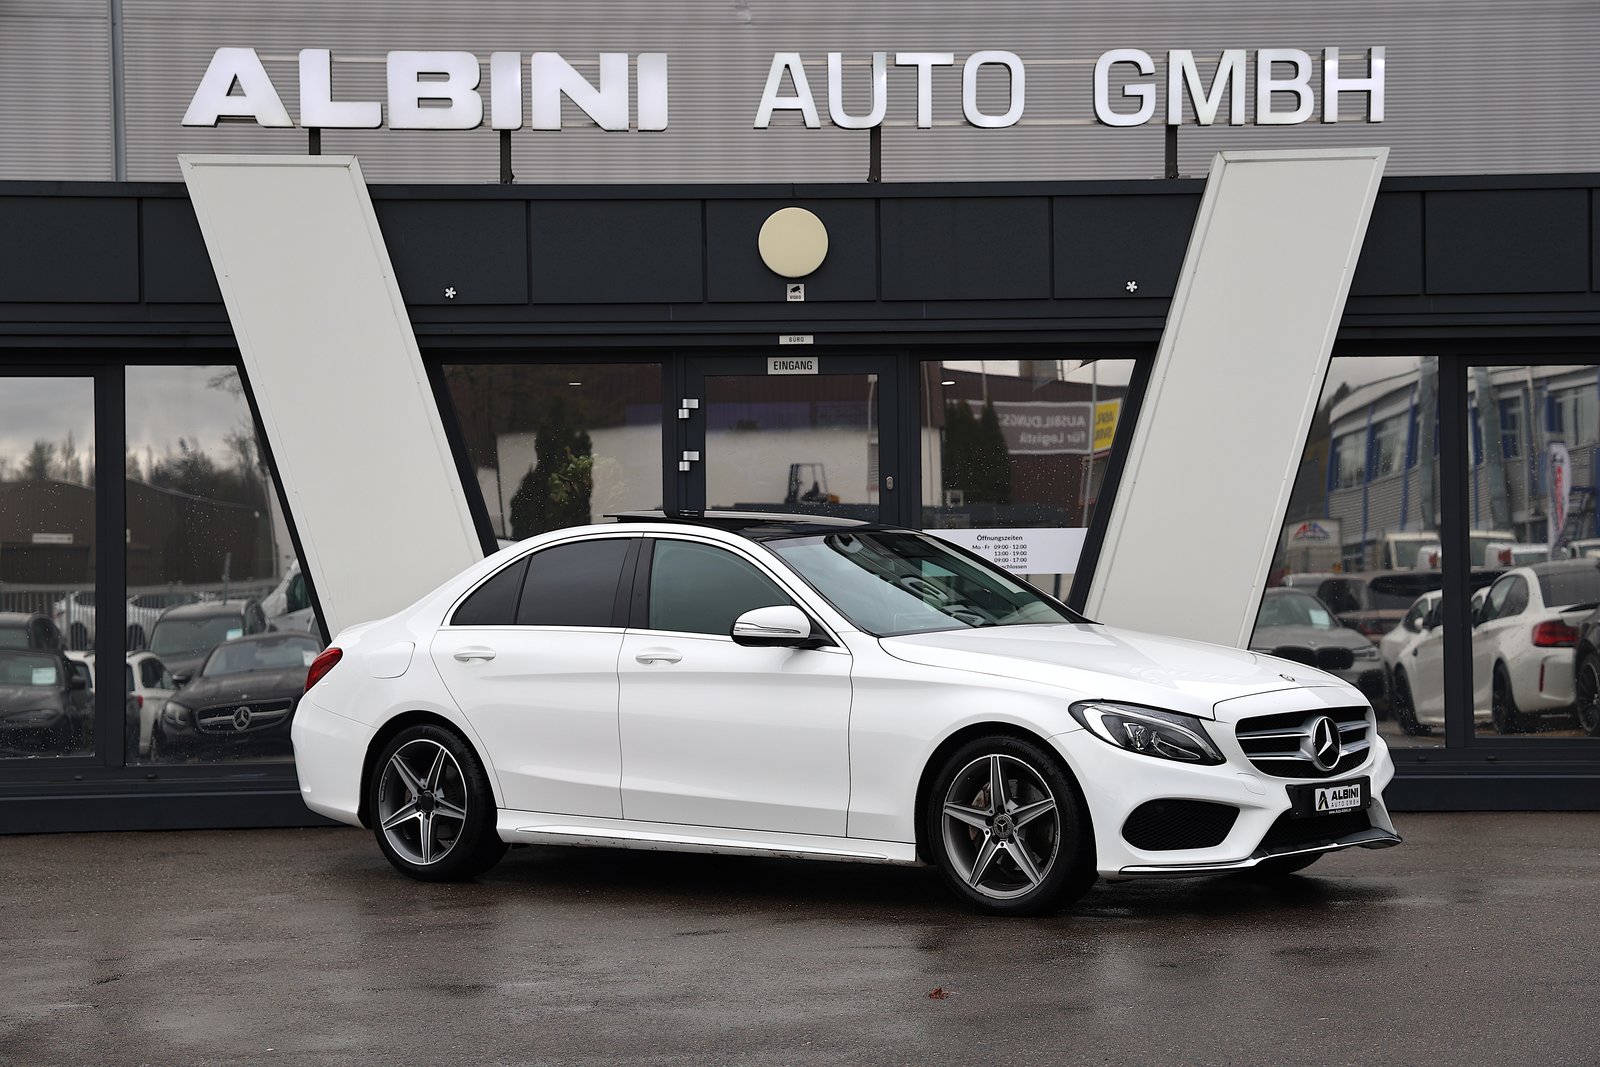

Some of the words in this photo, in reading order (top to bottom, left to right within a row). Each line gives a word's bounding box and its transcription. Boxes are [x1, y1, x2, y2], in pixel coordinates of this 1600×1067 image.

[181, 47, 668, 132] ALBINI
[753, 50, 1026, 130] AUTO
[1094, 45, 1386, 127] GMBH
[773, 360, 813, 371] EINGANG
[976, 534, 1023, 542] Öffnungszeiten
[1331, 788, 1359, 801] ALBINI
